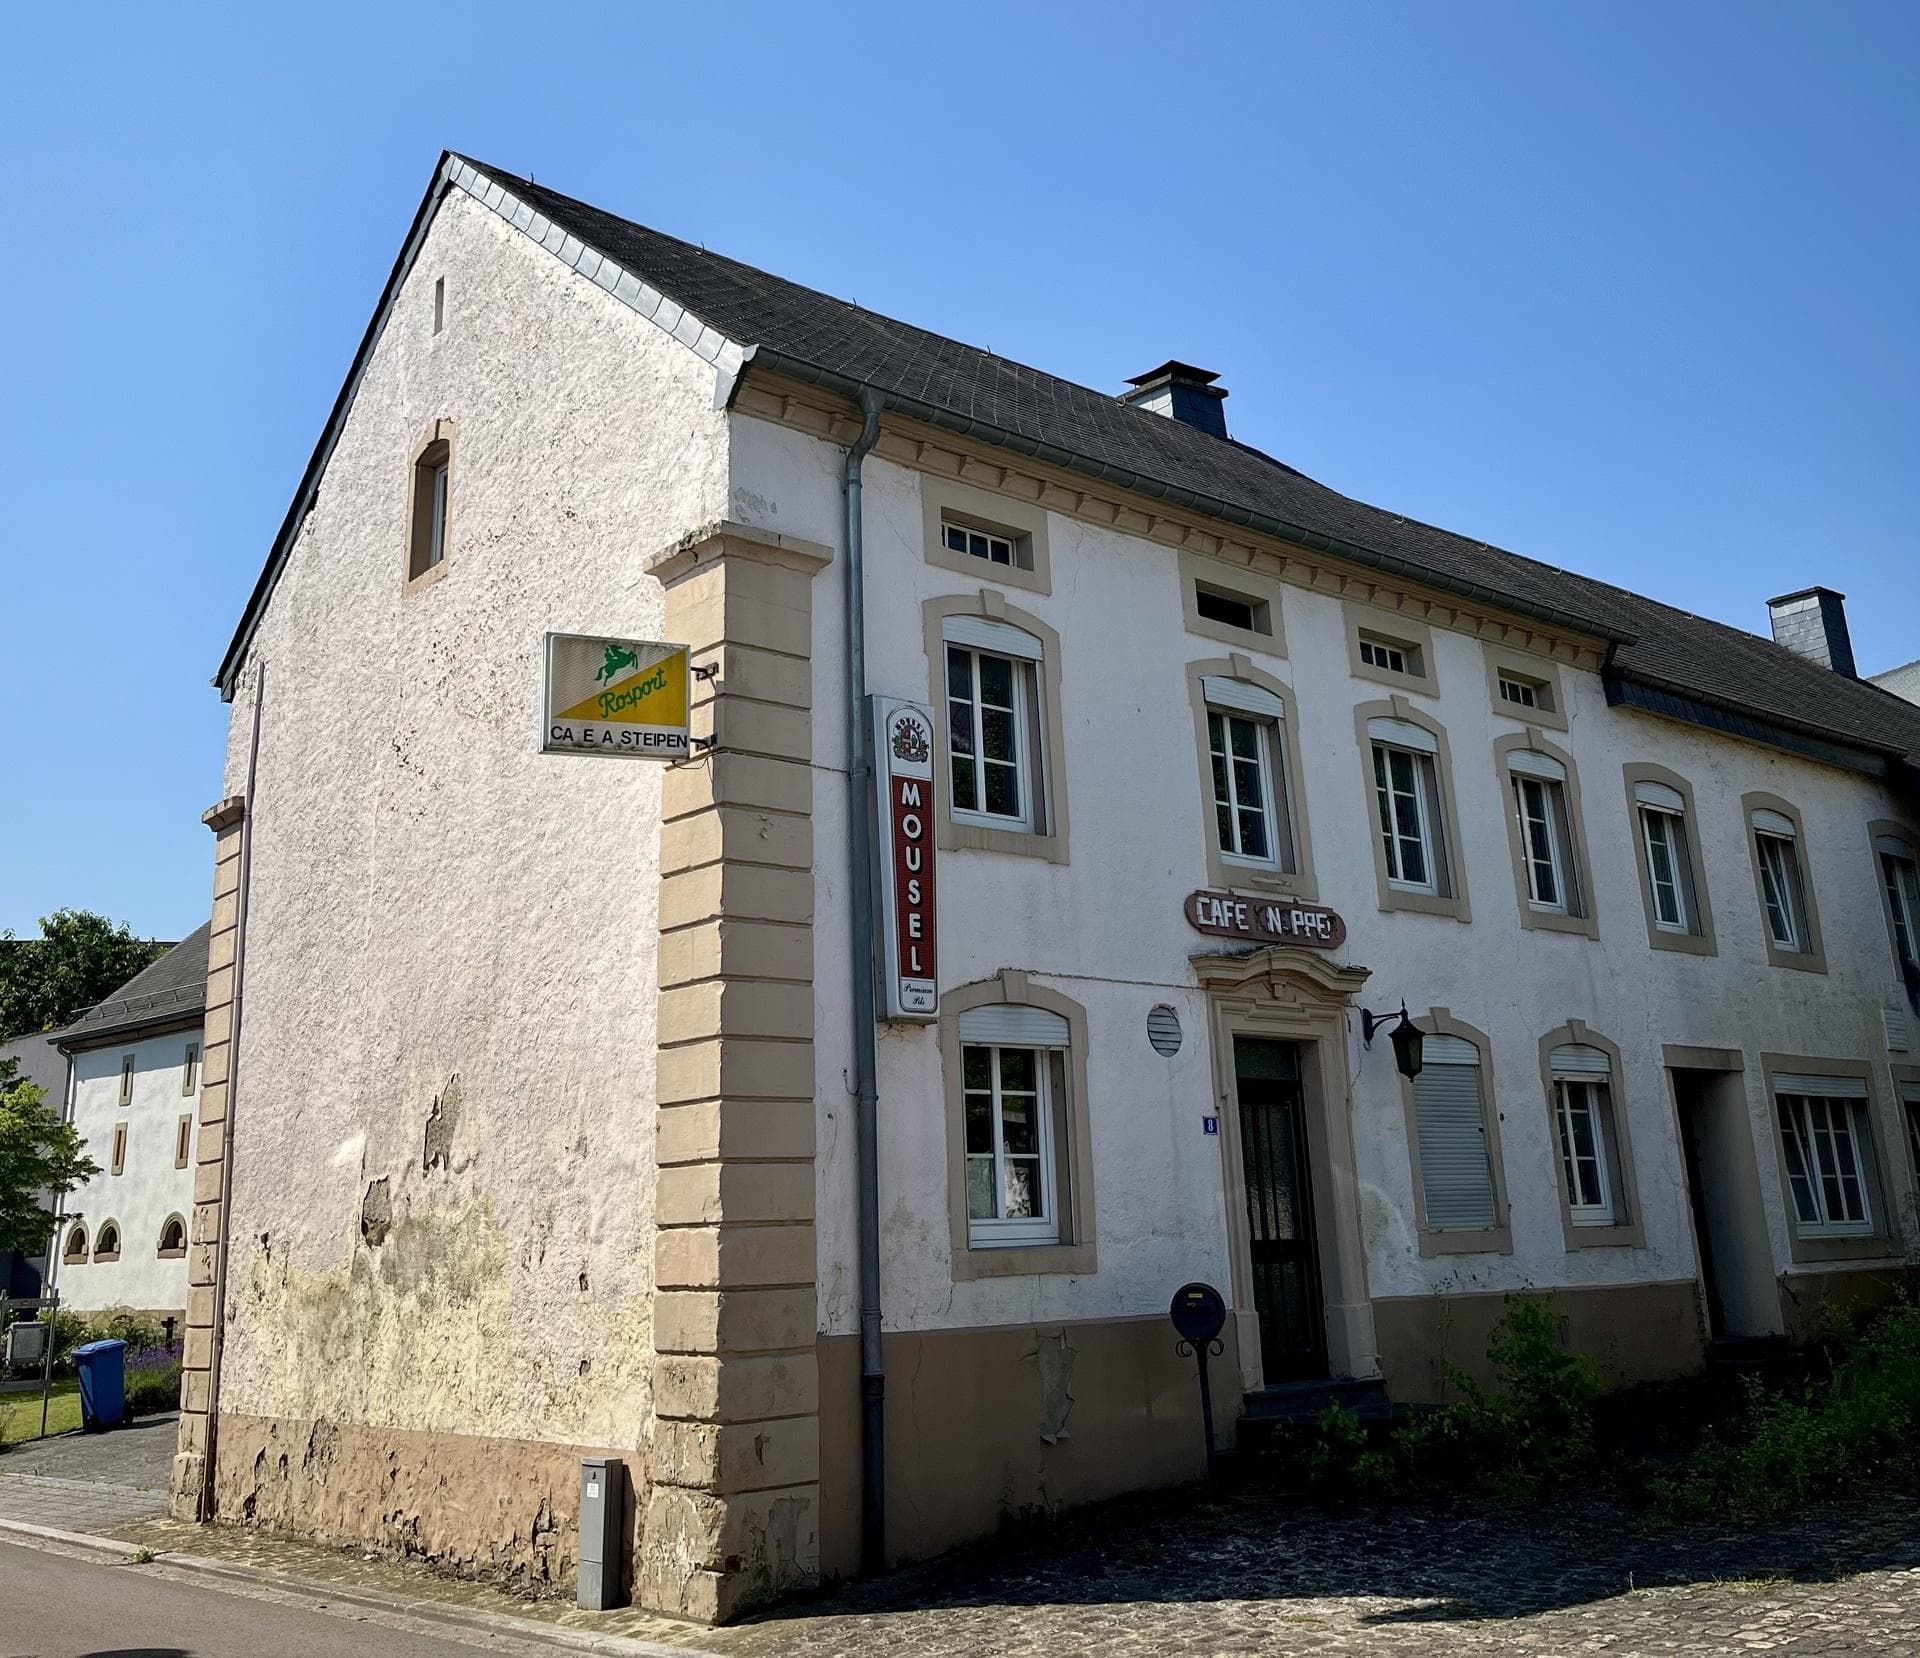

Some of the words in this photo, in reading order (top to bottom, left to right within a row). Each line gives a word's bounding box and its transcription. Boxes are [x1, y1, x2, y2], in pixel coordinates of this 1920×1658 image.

[598, 667, 667, 718] Rosport
[551, 726, 594, 743] CAE
[620, 730, 688, 748] STEIPEN
[901, 781, 922, 972] MOUSEL
[1195, 896, 1250, 931] CAFE
[1207, 1118, 1214, 1132] 8
